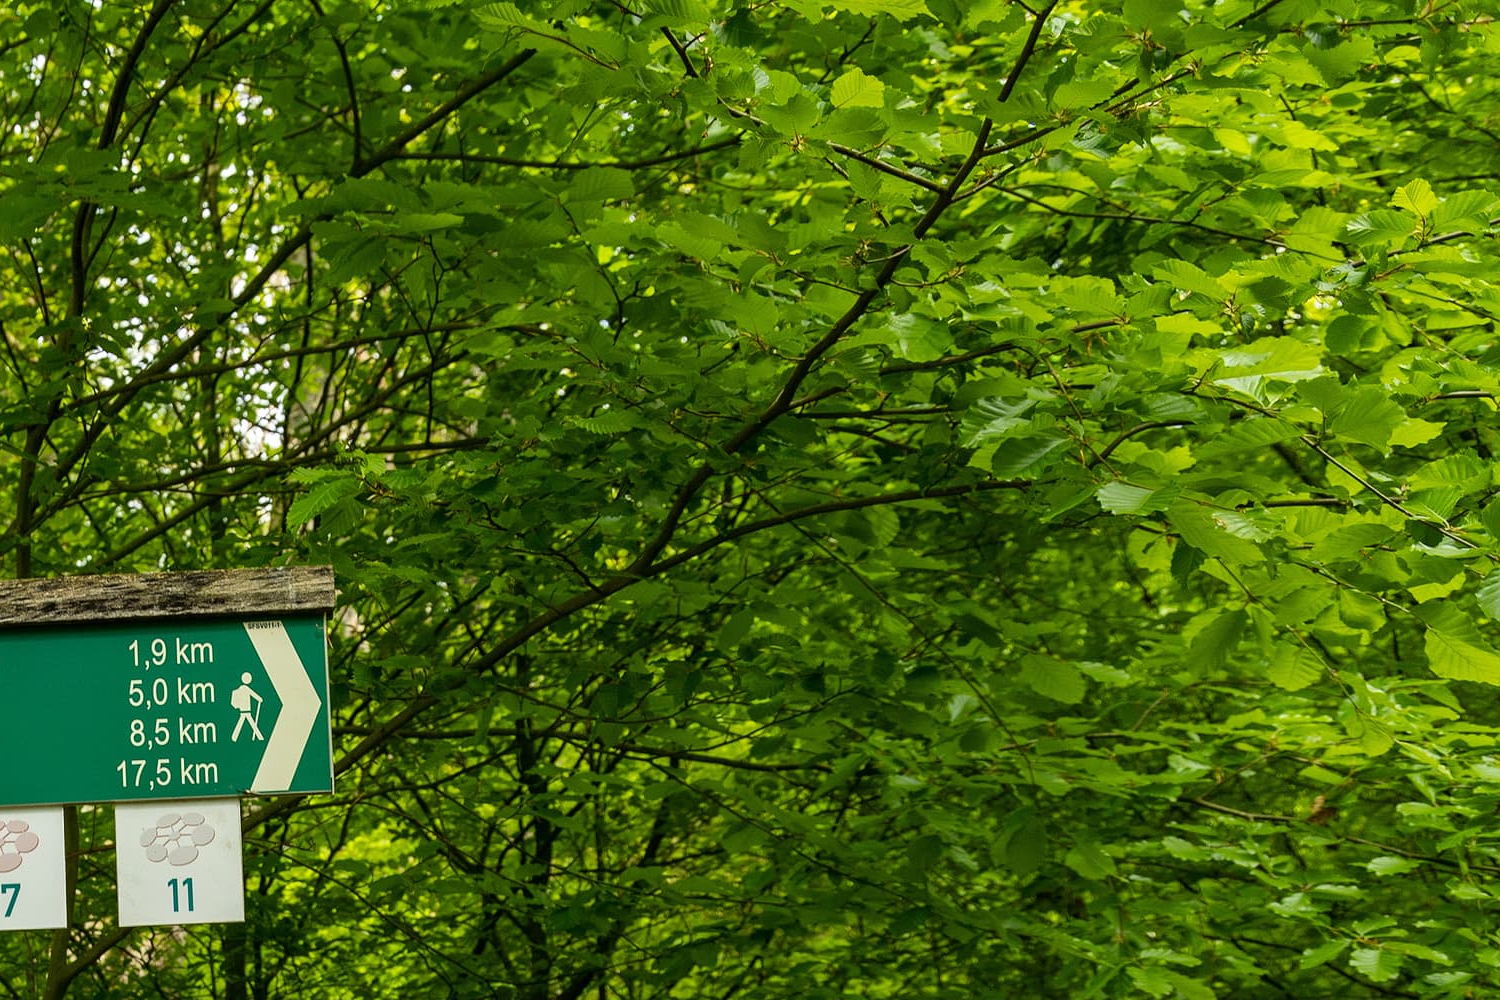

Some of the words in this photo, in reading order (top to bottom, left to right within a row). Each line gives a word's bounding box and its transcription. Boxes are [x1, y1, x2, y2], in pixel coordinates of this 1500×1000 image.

[128, 638, 168, 669] 1,9
[175, 638, 214, 664] km
[128, 678, 169, 709] 5,0
[176, 678, 216, 704] km
[129, 718, 170, 749] 8,5
[177, 718, 217, 745] km
[115, 758, 173, 789] 17,5
[180, 758, 219, 784] km
[167, 877, 196, 912] 11
